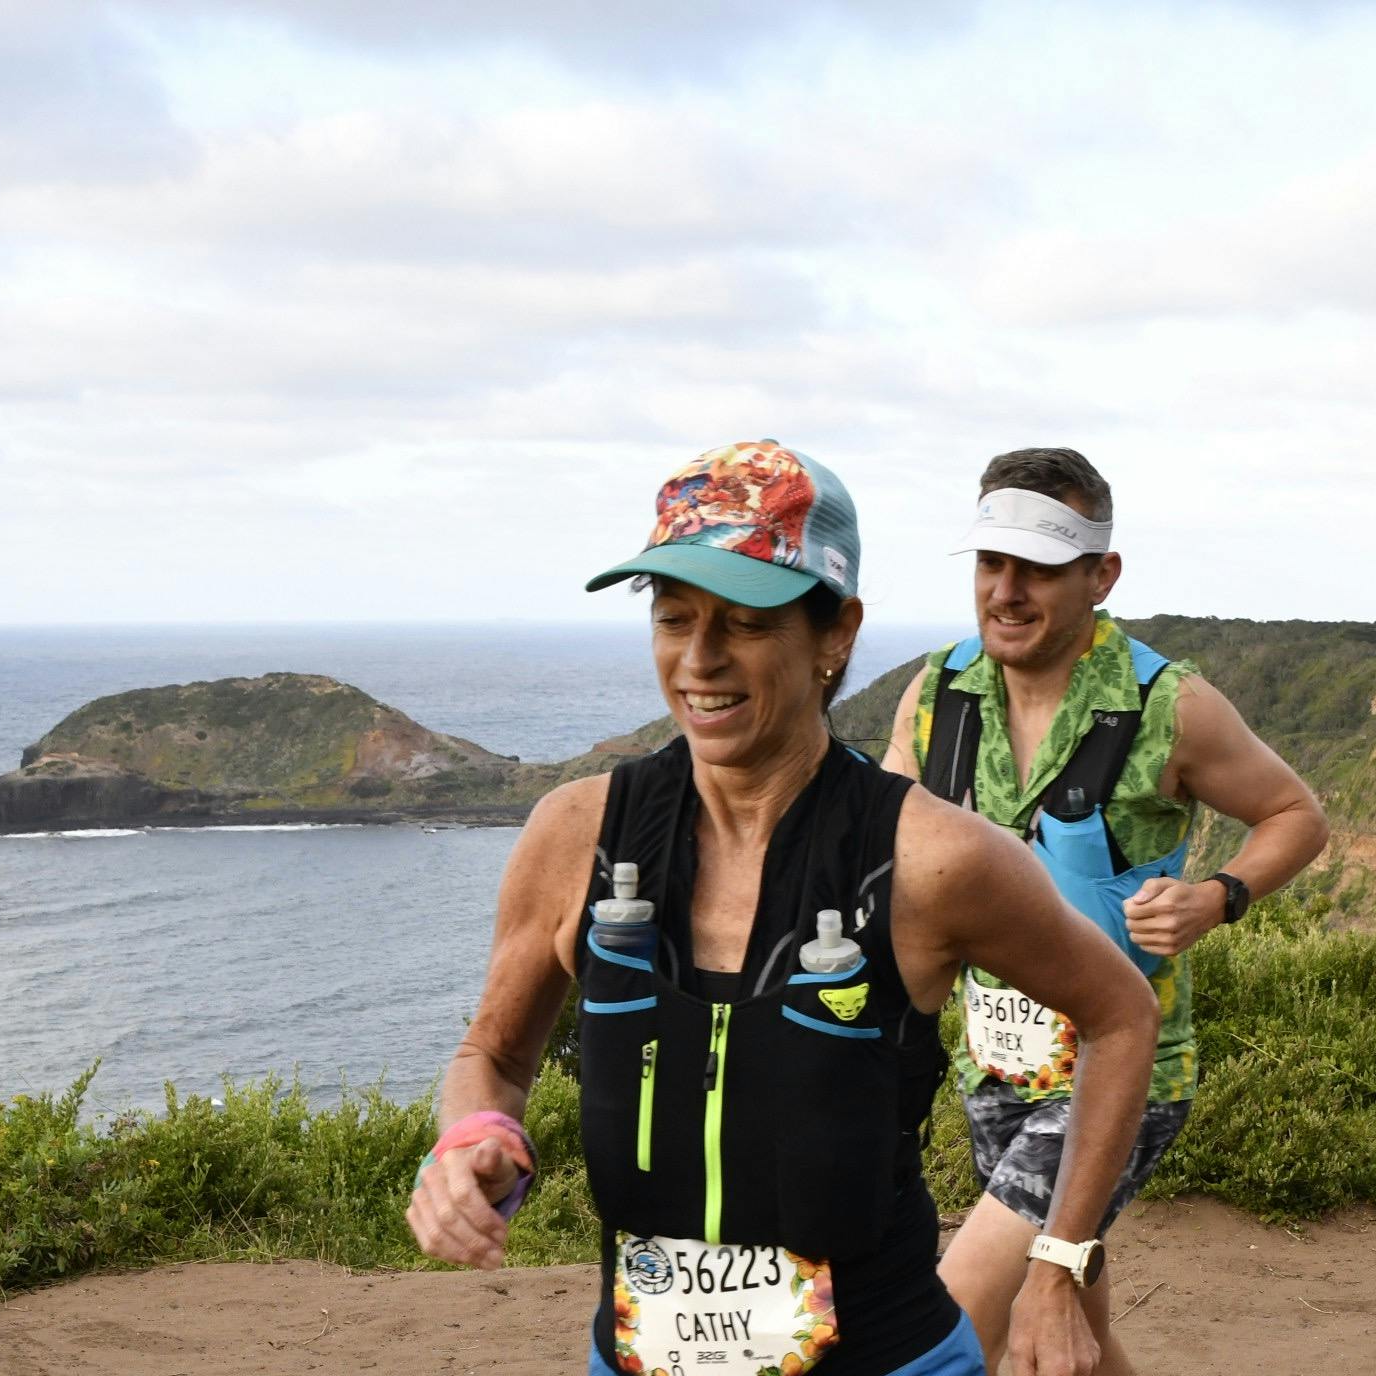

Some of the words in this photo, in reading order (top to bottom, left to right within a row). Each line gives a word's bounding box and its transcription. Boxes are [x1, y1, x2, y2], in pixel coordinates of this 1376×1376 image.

[1036, 519, 1078, 540] 2XU
[983, 993, 1046, 1025] 56192
[983, 1026, 1024, 1053] T-REX
[676, 1246, 781, 1295] 56223
[676, 1309, 752, 1342] CATHY
